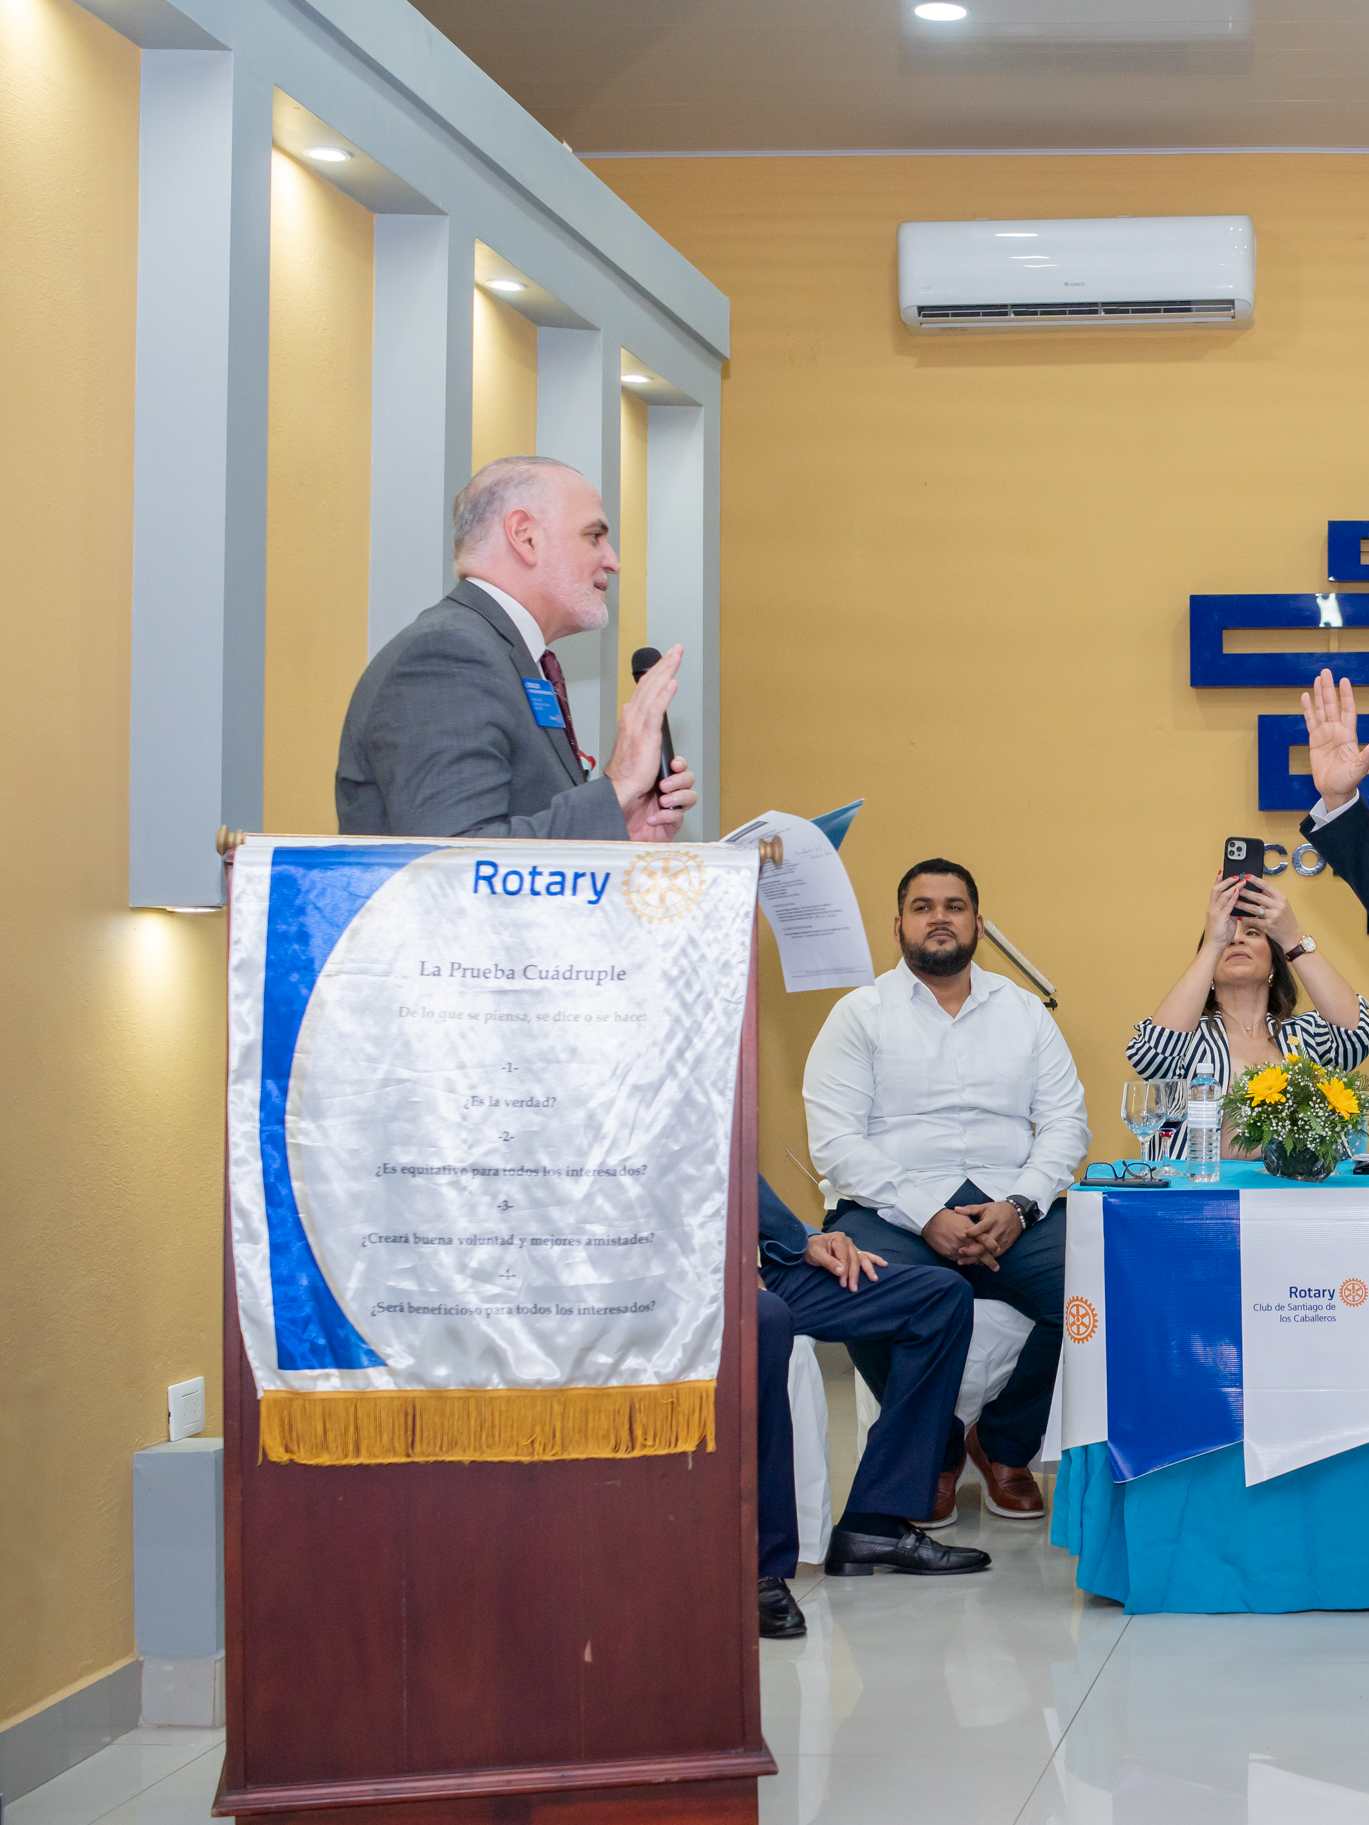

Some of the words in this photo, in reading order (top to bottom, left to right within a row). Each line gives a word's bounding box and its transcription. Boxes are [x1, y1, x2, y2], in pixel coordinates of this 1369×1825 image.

[473, 860, 611, 905] Rotary
[419, 961, 441, 977] La
[450, 962, 515, 980] Prueba
[523, 964, 627, 986] Cuádruple
[399, 1006, 417, 1018] De
[421, 1006, 435, 1018] lo
[439, 1010, 464, 1022] que
[467, 1012, 480, 1020] se
[536, 1013, 550, 1022] se
[553, 1010, 580, 1022] dice
[464, 1096, 485, 1110] ¿Es
[488, 1096, 500, 1108] la
[504, 1096, 557, 1108] verdad?
[498, 1131, 515, 1142] -2-
[376, 1163, 397, 1177] ¿Es
[401, 1165, 468, 1178] equitativo
[472, 1167, 499, 1179] para
[503, 1165, 539, 1176] todos
[543, 1165, 561, 1176] los
[566, 1164, 648, 1177] interesados?
[413, 1232, 453, 1245] buena
[458, 1234, 514, 1246] voluntad
[519, 1237, 527, 1248] y
[530, 1234, 580, 1248] mejores
[585, 1232, 655, 1246] amistades?
[1289, 1286, 1336, 1300] Rotary
[408, 1302, 482, 1315] beneficioso
[485, 1307, 513, 1319] para
[516, 1304, 552, 1315] todos
[555, 1304, 574, 1315] los
[578, 1300, 656, 1316] interesados?
[1253, 1303, 1273, 1312] Club
[1275, 1303, 1285, 1312] de
[1288, 1303, 1323, 1313] Santiago
[1325, 1302, 1336, 1311] de
[1279, 1314, 1292, 1323] los
[1294, 1314, 1337, 1323] Caballeros
